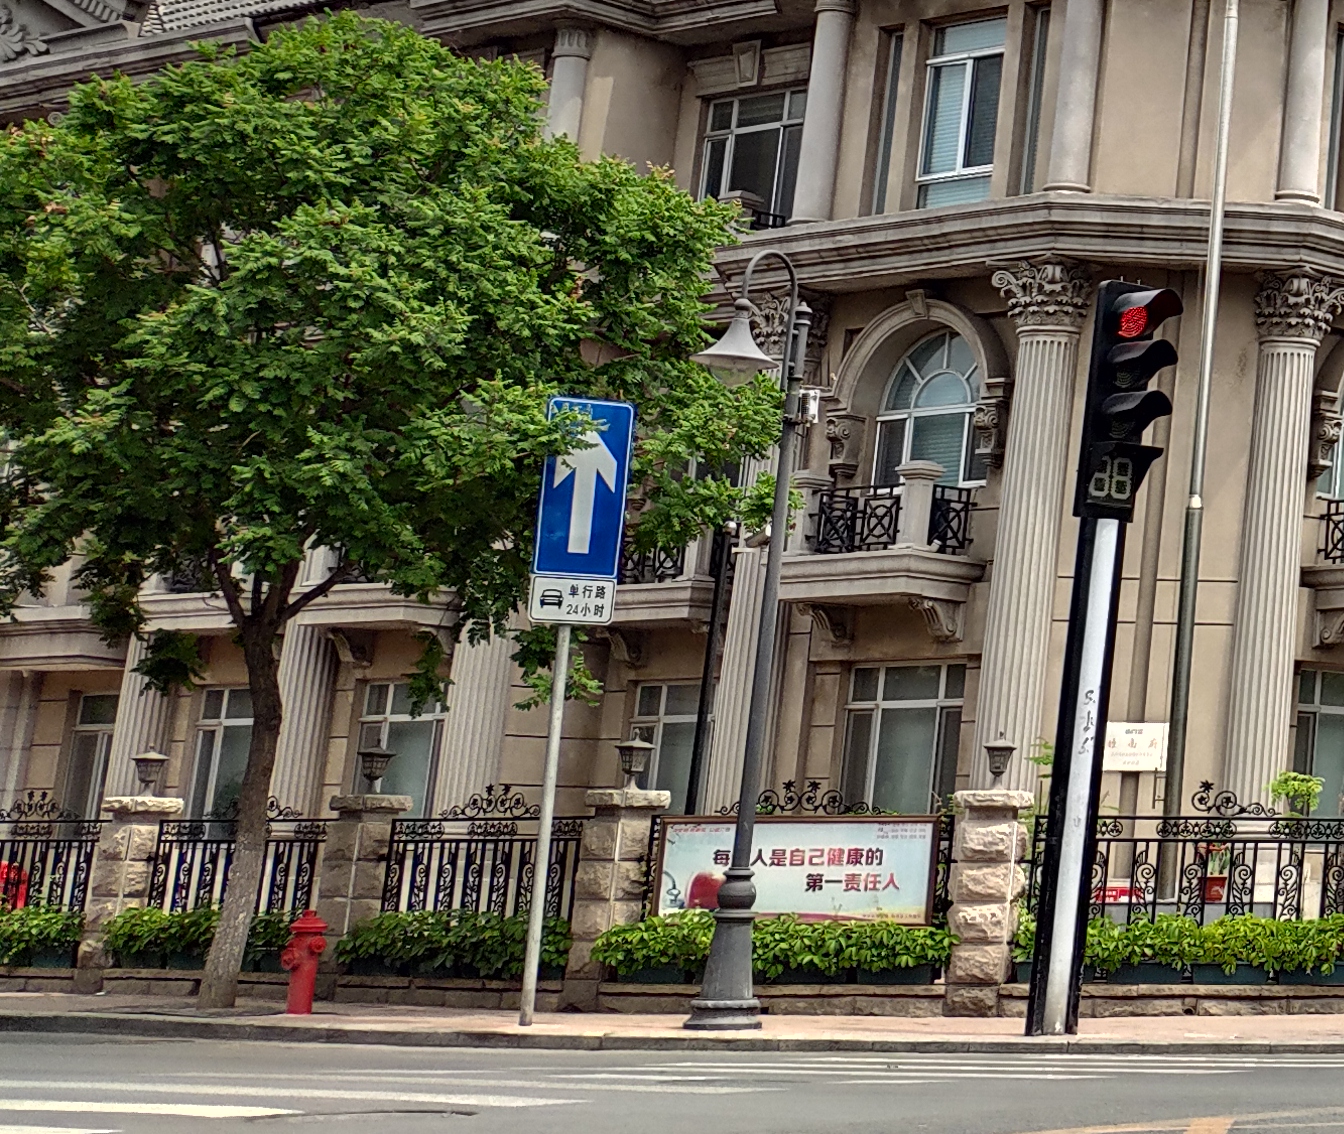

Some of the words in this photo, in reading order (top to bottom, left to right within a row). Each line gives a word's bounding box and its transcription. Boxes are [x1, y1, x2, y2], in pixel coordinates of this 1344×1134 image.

[568, 584, 607, 600] 单行路
[566, 602, 605, 618] 24小时
[712, 847, 883, 867] 每人是自己健康的
[804, 872, 900, 893] 第一责任人
